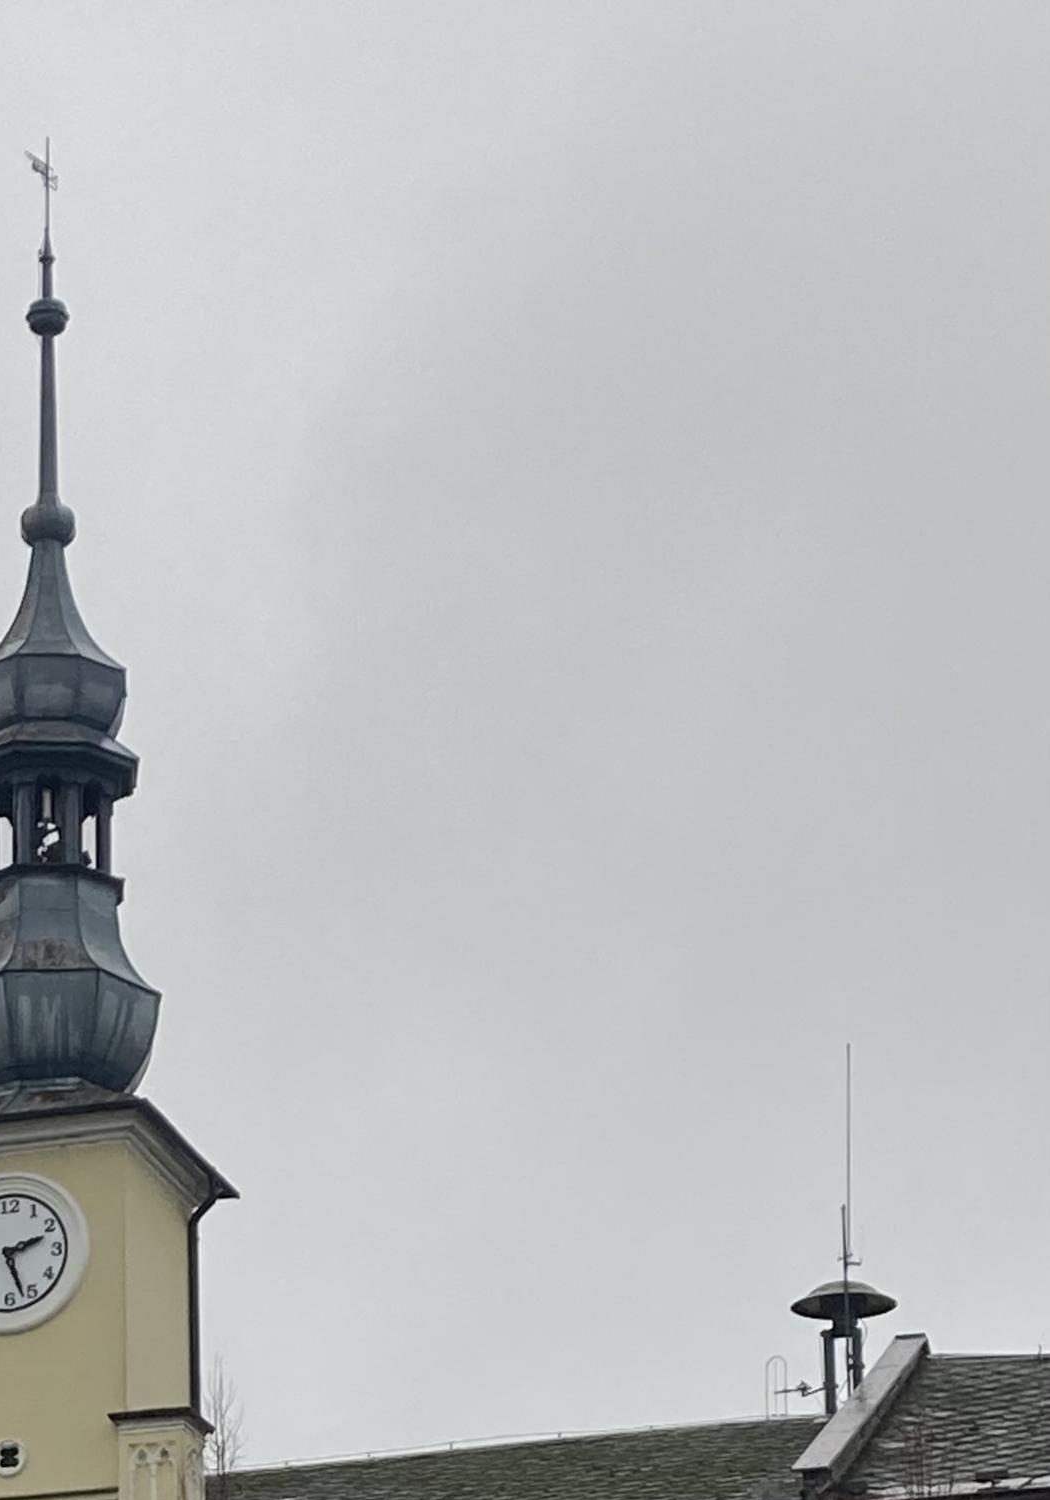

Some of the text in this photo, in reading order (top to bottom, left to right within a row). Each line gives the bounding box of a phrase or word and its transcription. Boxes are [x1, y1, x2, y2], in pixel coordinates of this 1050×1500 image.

[0, 1199, 20, 1214] 12
[30, 1204, 38, 1218] 1
[44, 1218, 56, 1232] 2
[51, 1242, 62, 1257] 3
[43, 1266, 54, 1280] 4
[27, 1284, 38, 1299] 5
[4, 1292, 16, 1306] 6
